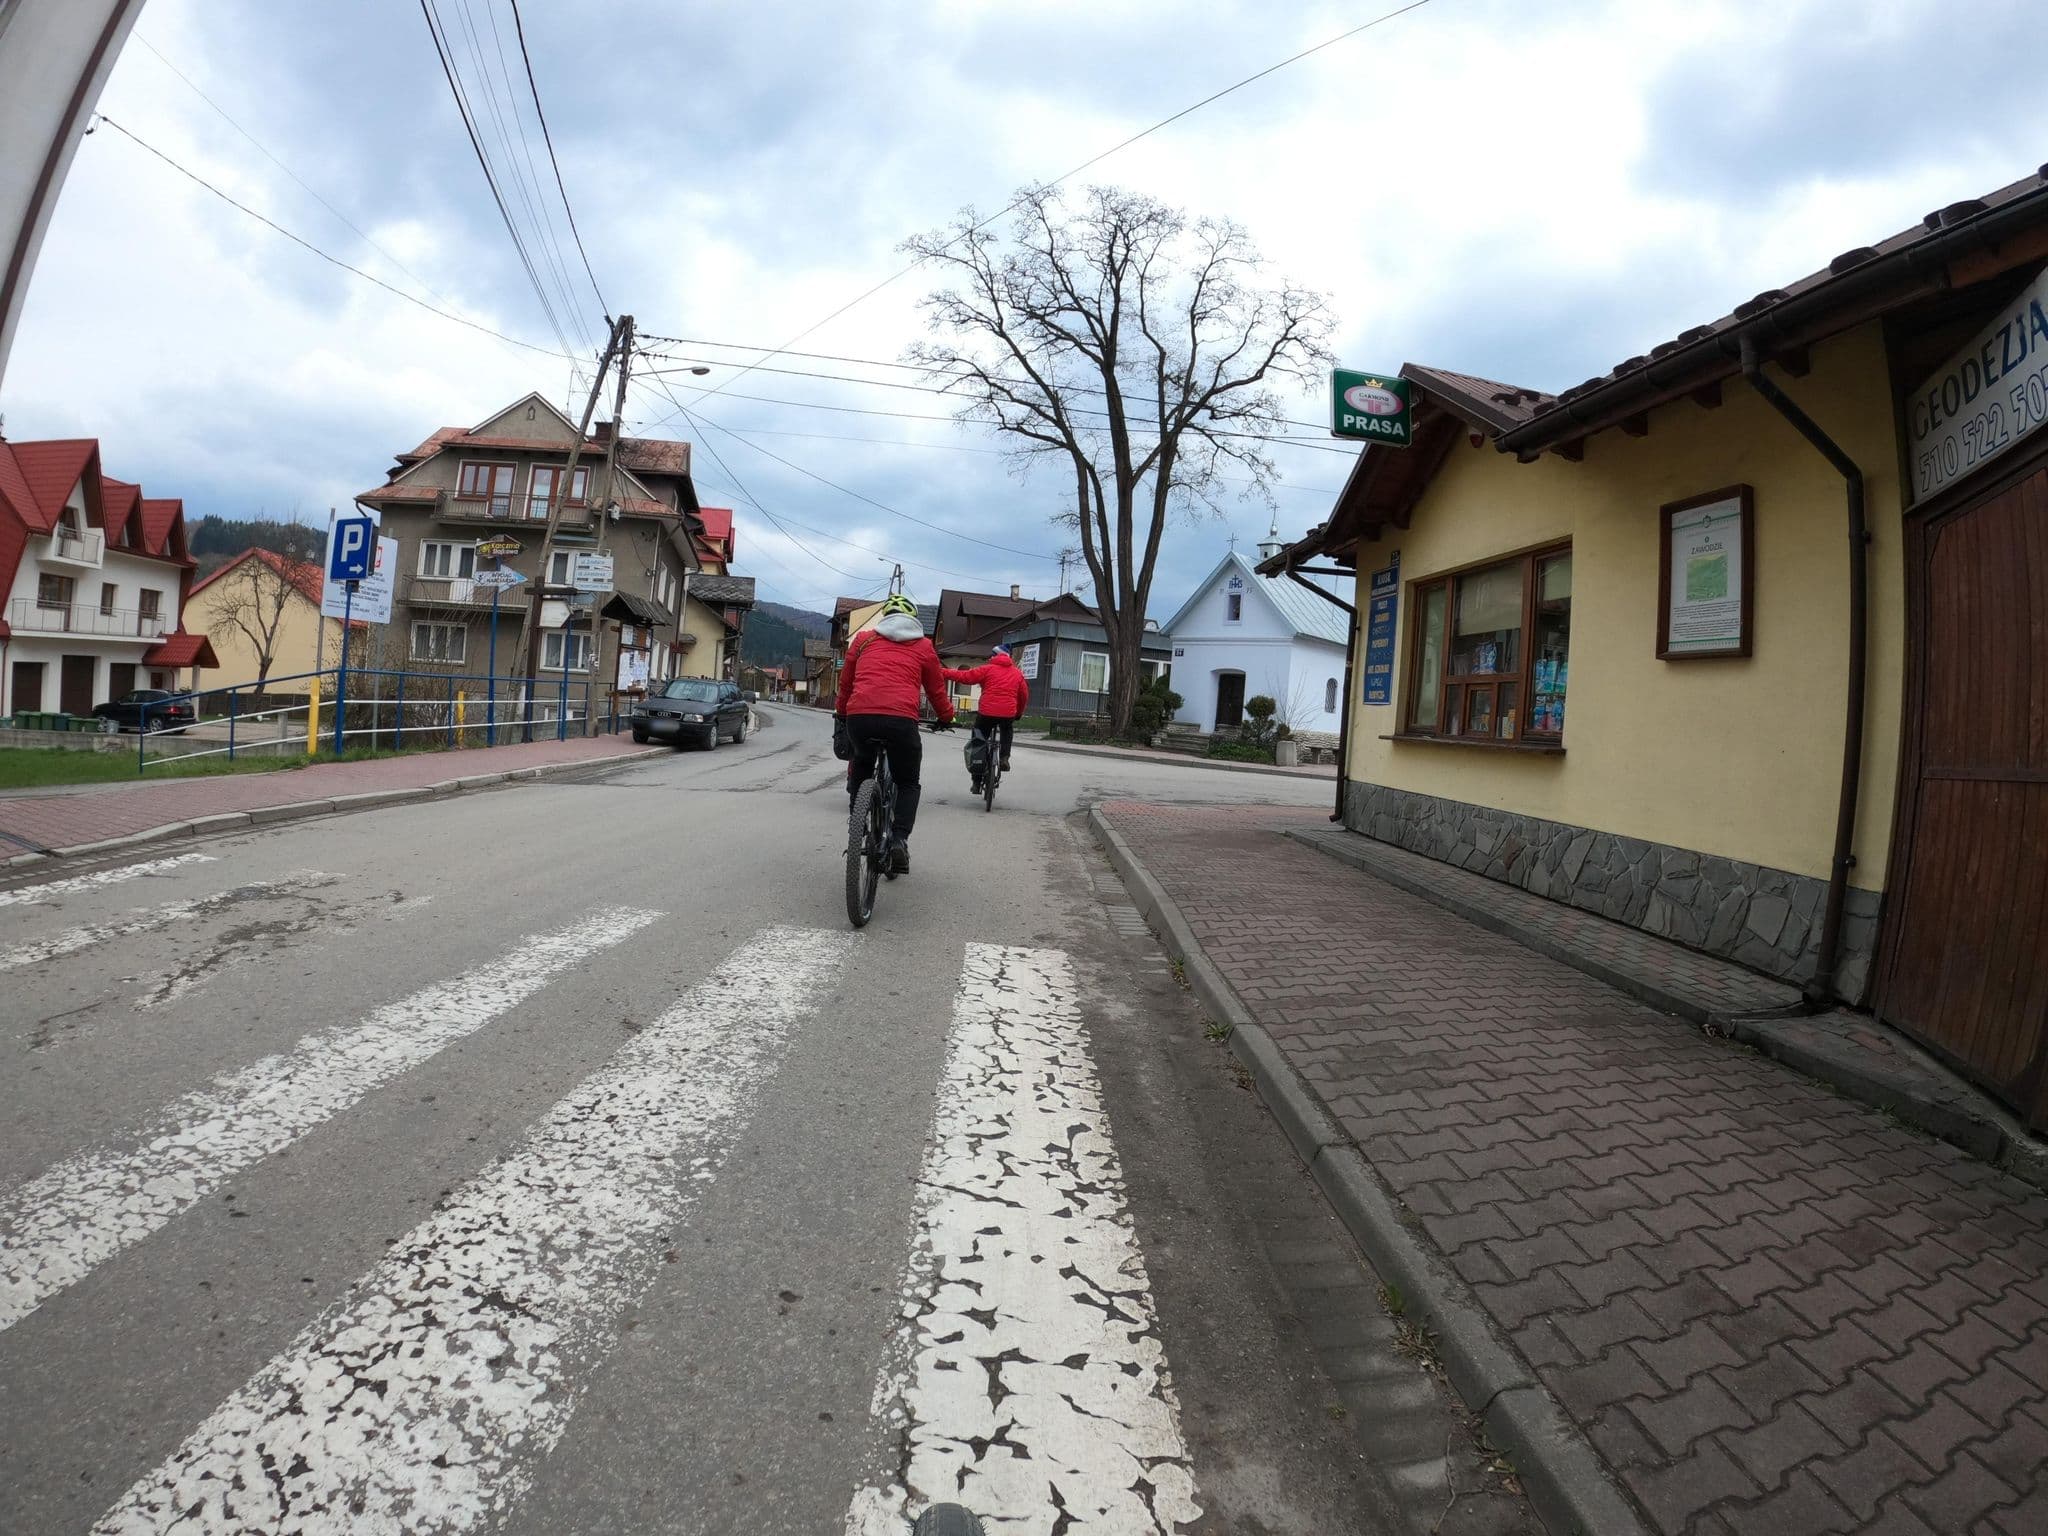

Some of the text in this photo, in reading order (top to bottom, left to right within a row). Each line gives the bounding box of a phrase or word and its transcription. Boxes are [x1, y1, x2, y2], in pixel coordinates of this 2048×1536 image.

[1914, 298, 2048, 441] GEODEZJA
[1343, 414, 1405, 436] PRASA
[1919, 435, 1959, 493] 510
[1961, 402, 2009, 467] 522
[340, 523, 364, 562] P
